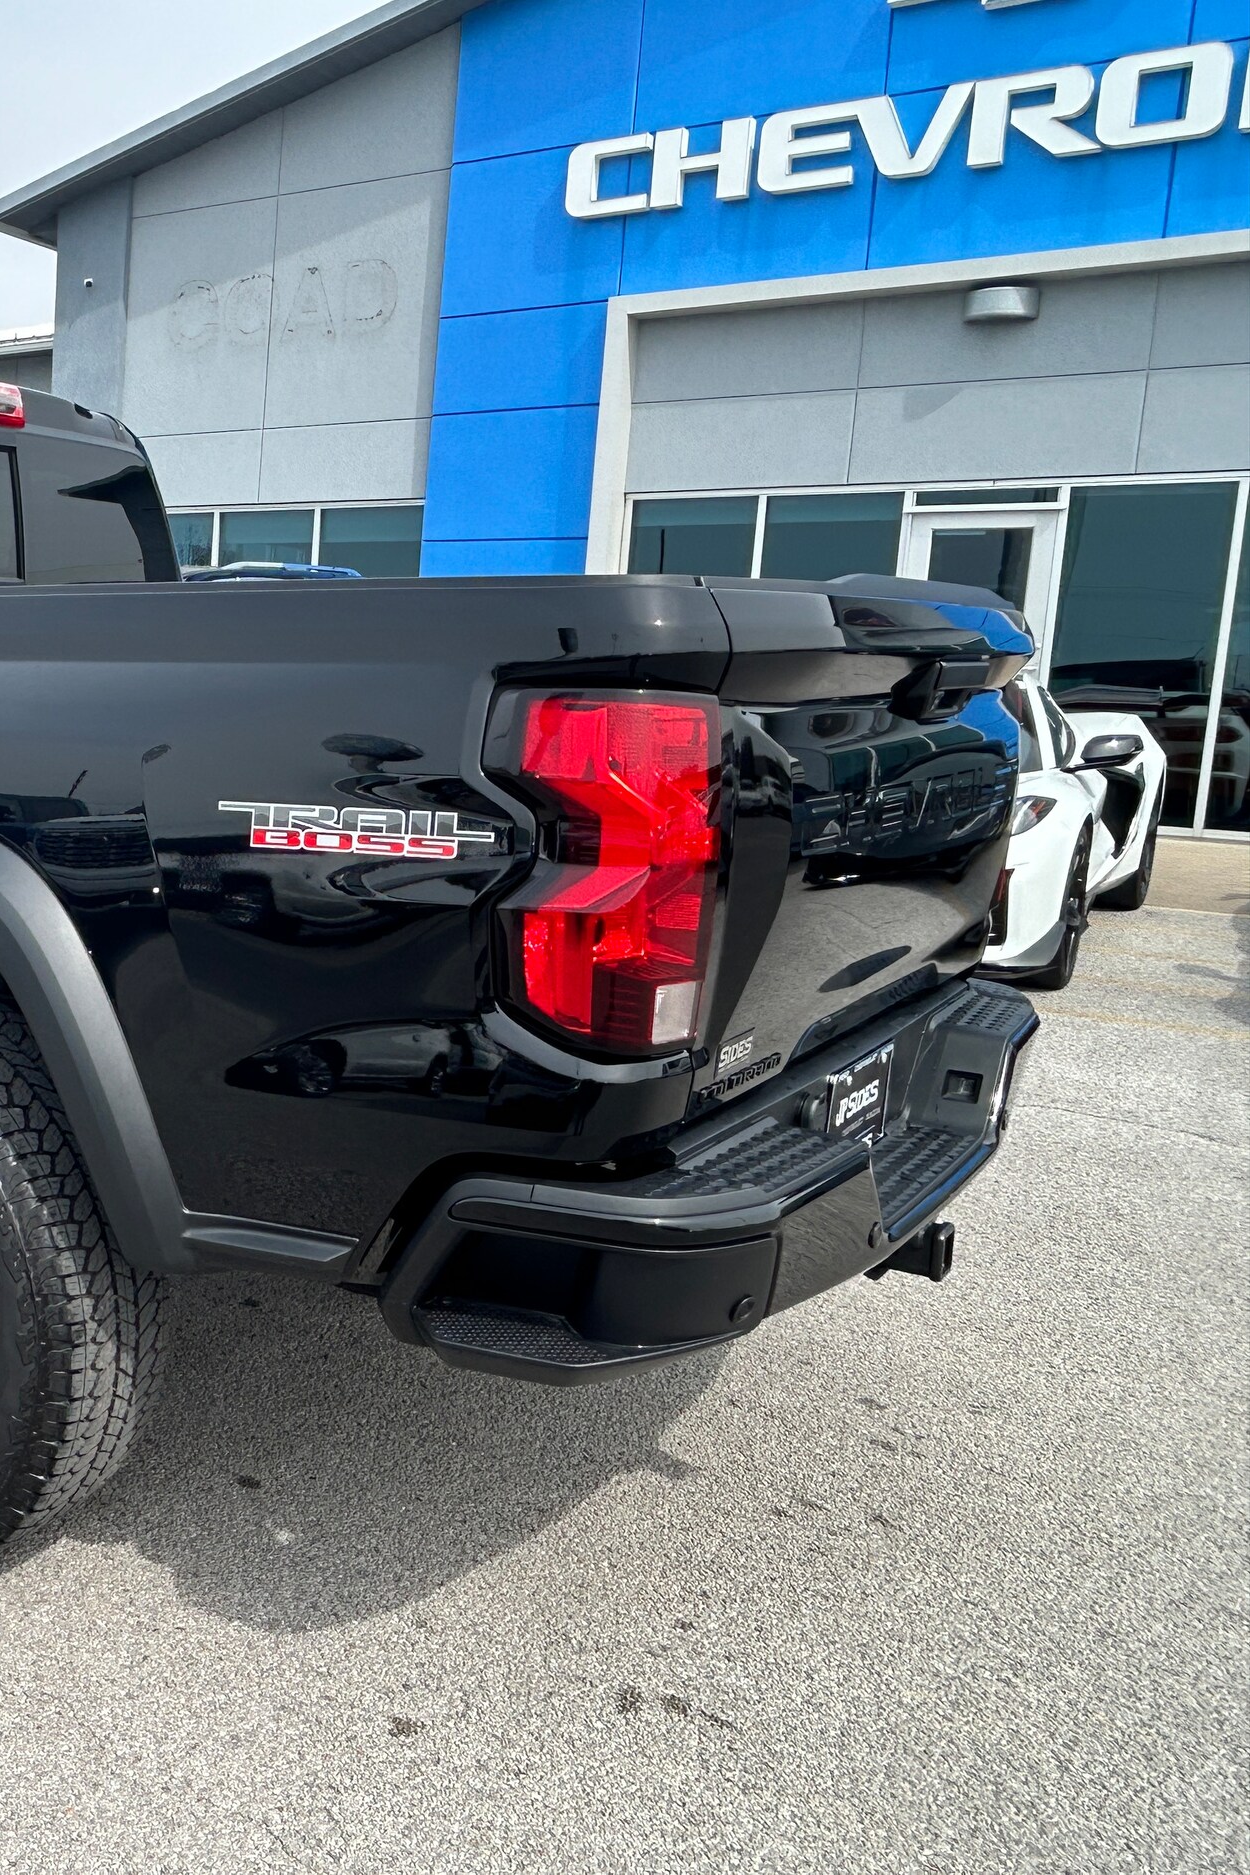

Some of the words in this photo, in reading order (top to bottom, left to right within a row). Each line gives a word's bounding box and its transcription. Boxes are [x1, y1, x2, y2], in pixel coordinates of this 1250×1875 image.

[565, 42, 1250, 219] CHEVRO
[218, 800, 495, 843] TRAIL
[250, 827, 459, 860] BOSS
[718, 1036, 754, 1069] SIDES
